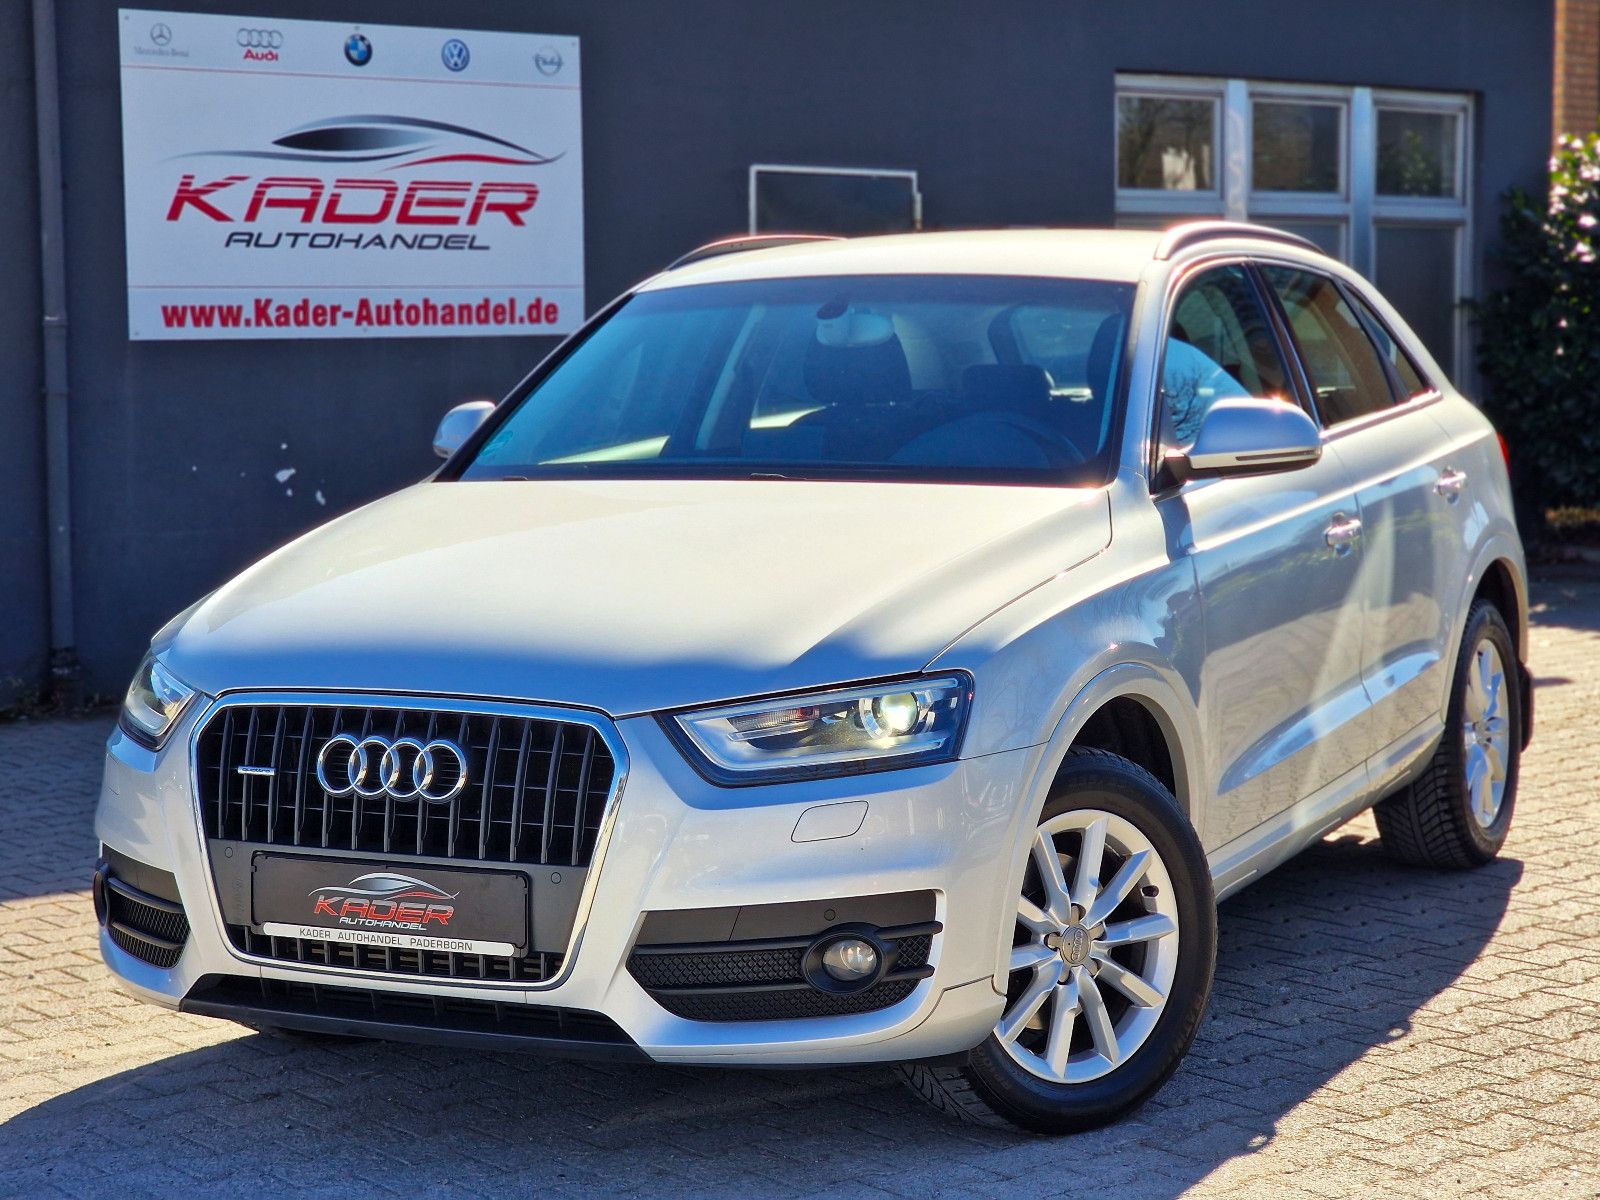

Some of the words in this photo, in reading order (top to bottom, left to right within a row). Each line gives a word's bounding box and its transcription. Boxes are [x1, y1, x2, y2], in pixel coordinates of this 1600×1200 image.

[243, 48, 279, 61] Audi
[166, 175, 540, 227] KADER
[224, 231, 491, 251] AUTOHANDEL
[161, 297, 559, 328] www.Kader-Autohandel.de
[312, 895, 455, 925] KADER
[339, 916, 428, 931] AUTOHANDEL
[299, 928, 331, 939] KADER
[337, 931, 403, 946] AUTOHANDEL
[410, 937, 473, 951] PADERBORN
